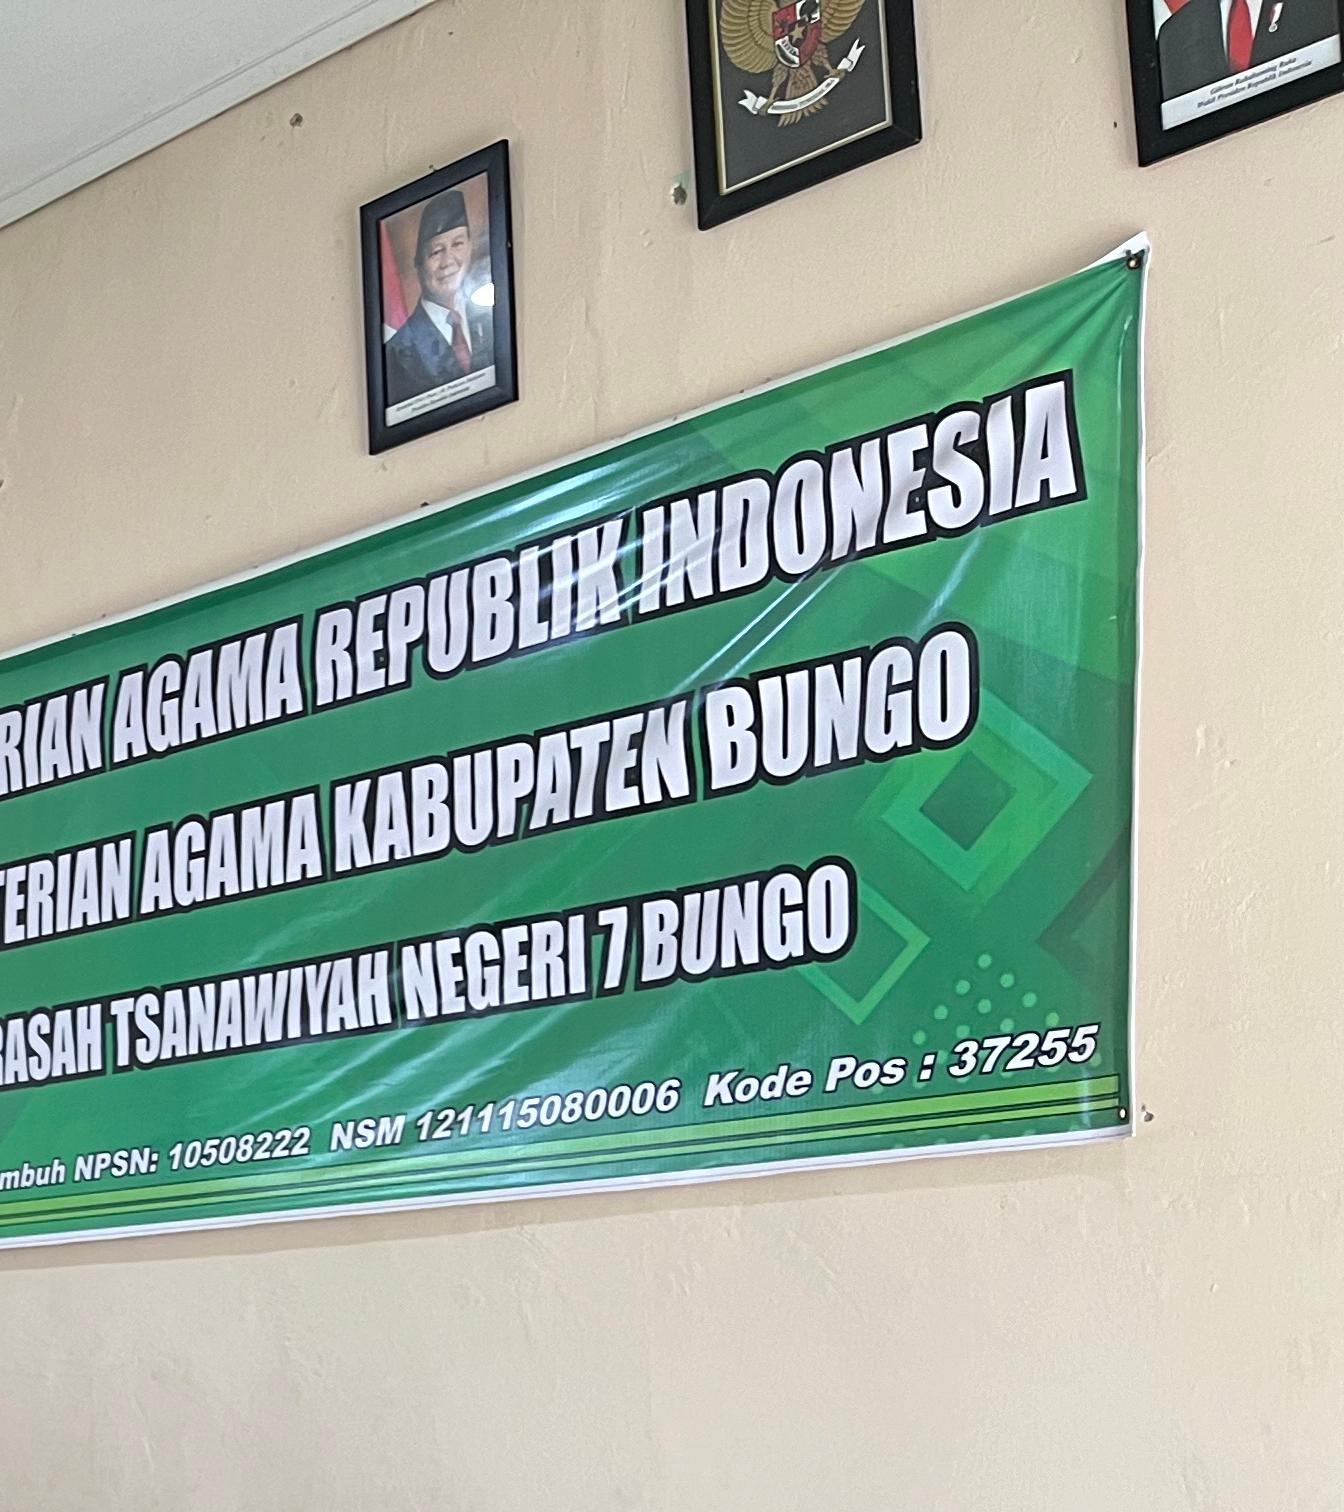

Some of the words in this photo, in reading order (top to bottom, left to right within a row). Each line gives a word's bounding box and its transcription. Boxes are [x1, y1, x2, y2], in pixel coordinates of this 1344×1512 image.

[112, 615, 308, 771] AGAMA
[313, 512, 630, 705] REPUBLIK
[636, 371, 1086, 614] INDONESIA
[139, 785, 329, 920] AGAMA
[331, 695, 696, 873] KABUPATEN
[702, 623, 979, 793] BUNGO
[110, 942, 397, 1073] TSANAWIYAH
[399, 904, 592, 1025] NEGERI
[594, 902, 631, 993] 7
[638, 858, 857, 988] BUNGO
[73, 1145, 159, 1181] NPSN:
[168, 1127, 311, 1172] 10508222
[330, 1115, 407, 1153] NSM
[416, 1078, 683, 1141] 121115080006
[702, 1063, 814, 1108] Kode
[823, 1055, 907, 1093] Pos
[948, 1022, 1101, 1077] 37255
